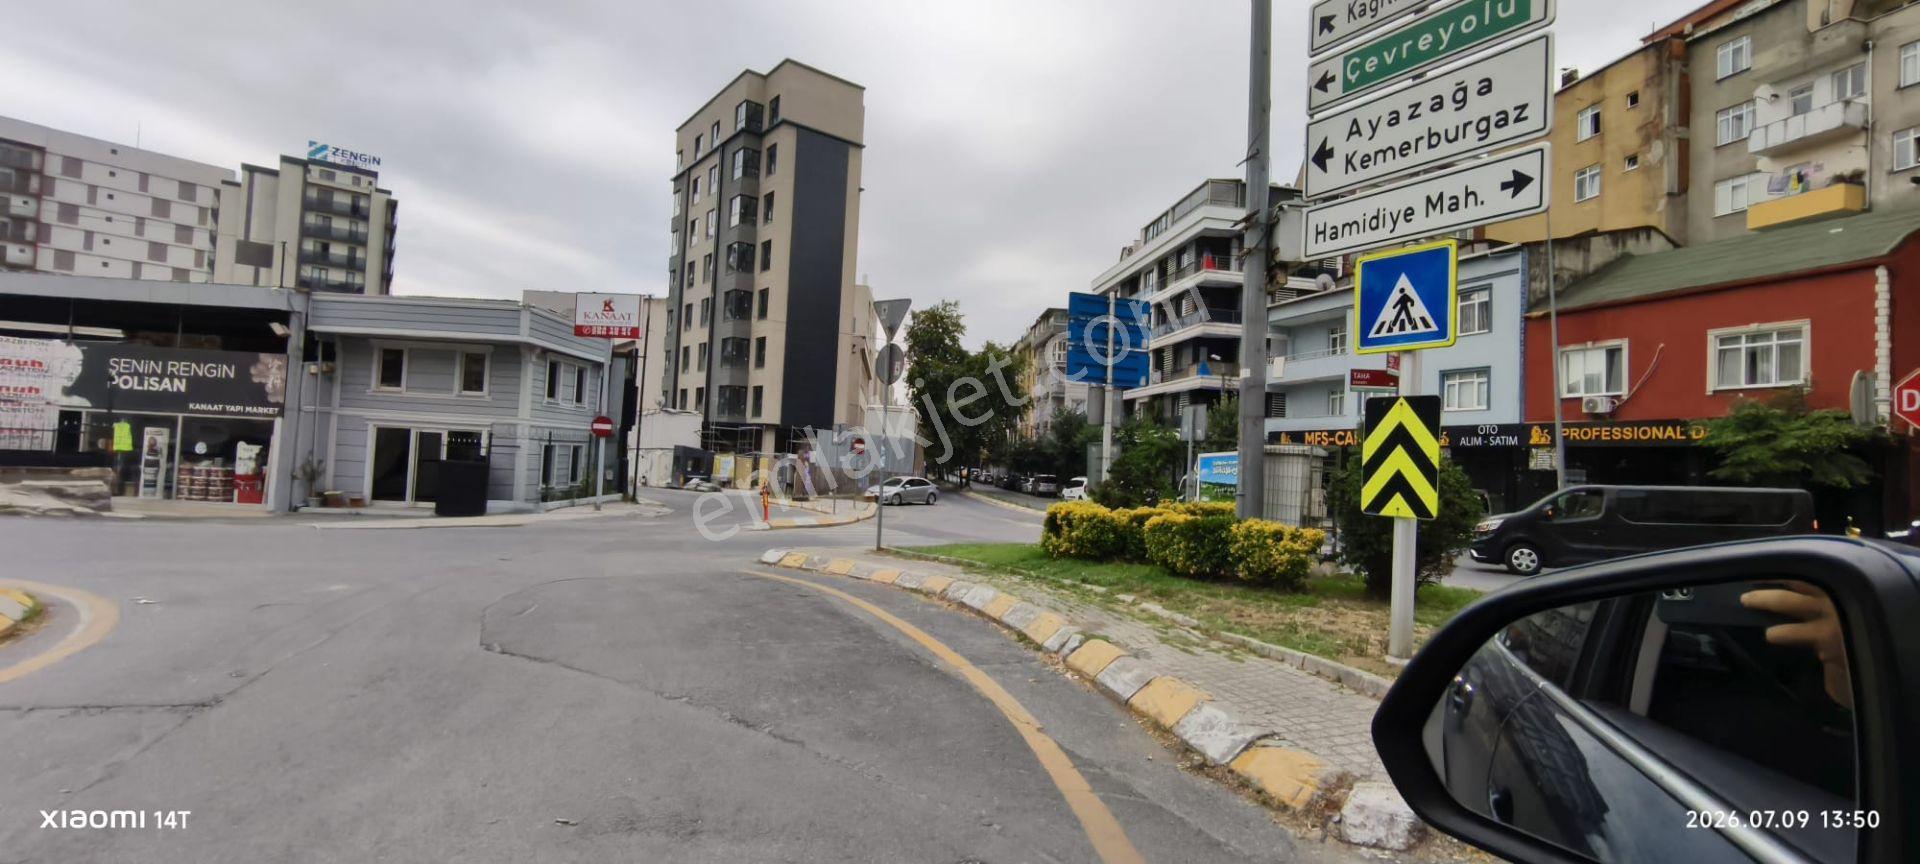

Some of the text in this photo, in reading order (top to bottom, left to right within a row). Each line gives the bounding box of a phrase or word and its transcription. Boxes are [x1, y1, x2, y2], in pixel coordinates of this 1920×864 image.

[1346, 0, 1515, 82] Çevreyolu
[1346, 77, 1493, 141] Ayazağa
[1344, 103, 1529, 174] Kemerburgaz
[1315, 185, 1485, 244] Hamidiye Mah.
[584, 312, 632, 321] KANAAT
[189, 403, 280, 415] KANAAT YAPI MARKET
[1477, 425, 1498, 435] OTO
[1562, 426, 1686, 440] PROFESSIONAL
[1459, 437, 1483, 446] ALIM
[1489, 436, 1518, 446] SATIM
